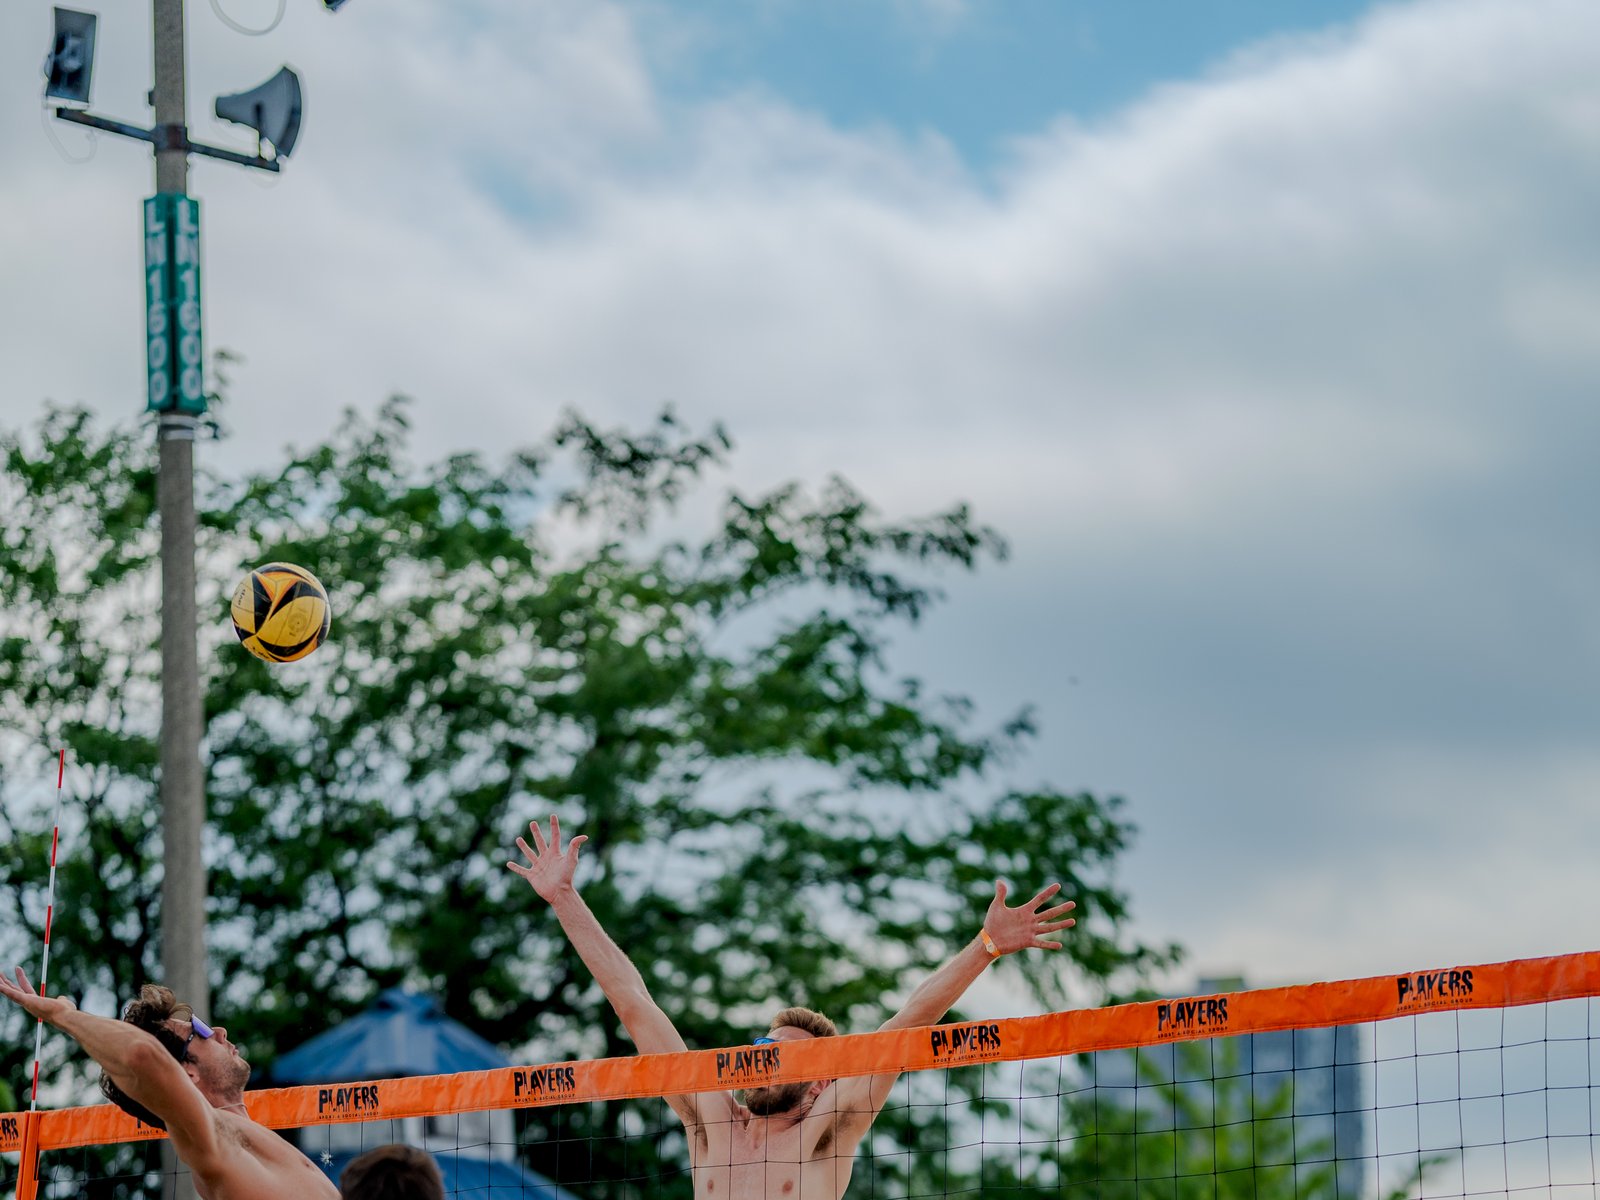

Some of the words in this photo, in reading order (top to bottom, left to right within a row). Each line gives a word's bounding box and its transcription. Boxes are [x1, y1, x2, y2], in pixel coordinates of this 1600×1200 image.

[1397, 970, 1473, 1004] PLAYERS
[1157, 998, 1228, 1031] PLAYERS
[931, 1024, 1001, 1056] PLAYERS
[716, 1047, 780, 1078] PLAYERS
[514, 1067, 576, 1096] PLAYERS
[319, 1085, 379, 1113] PLAYERS
